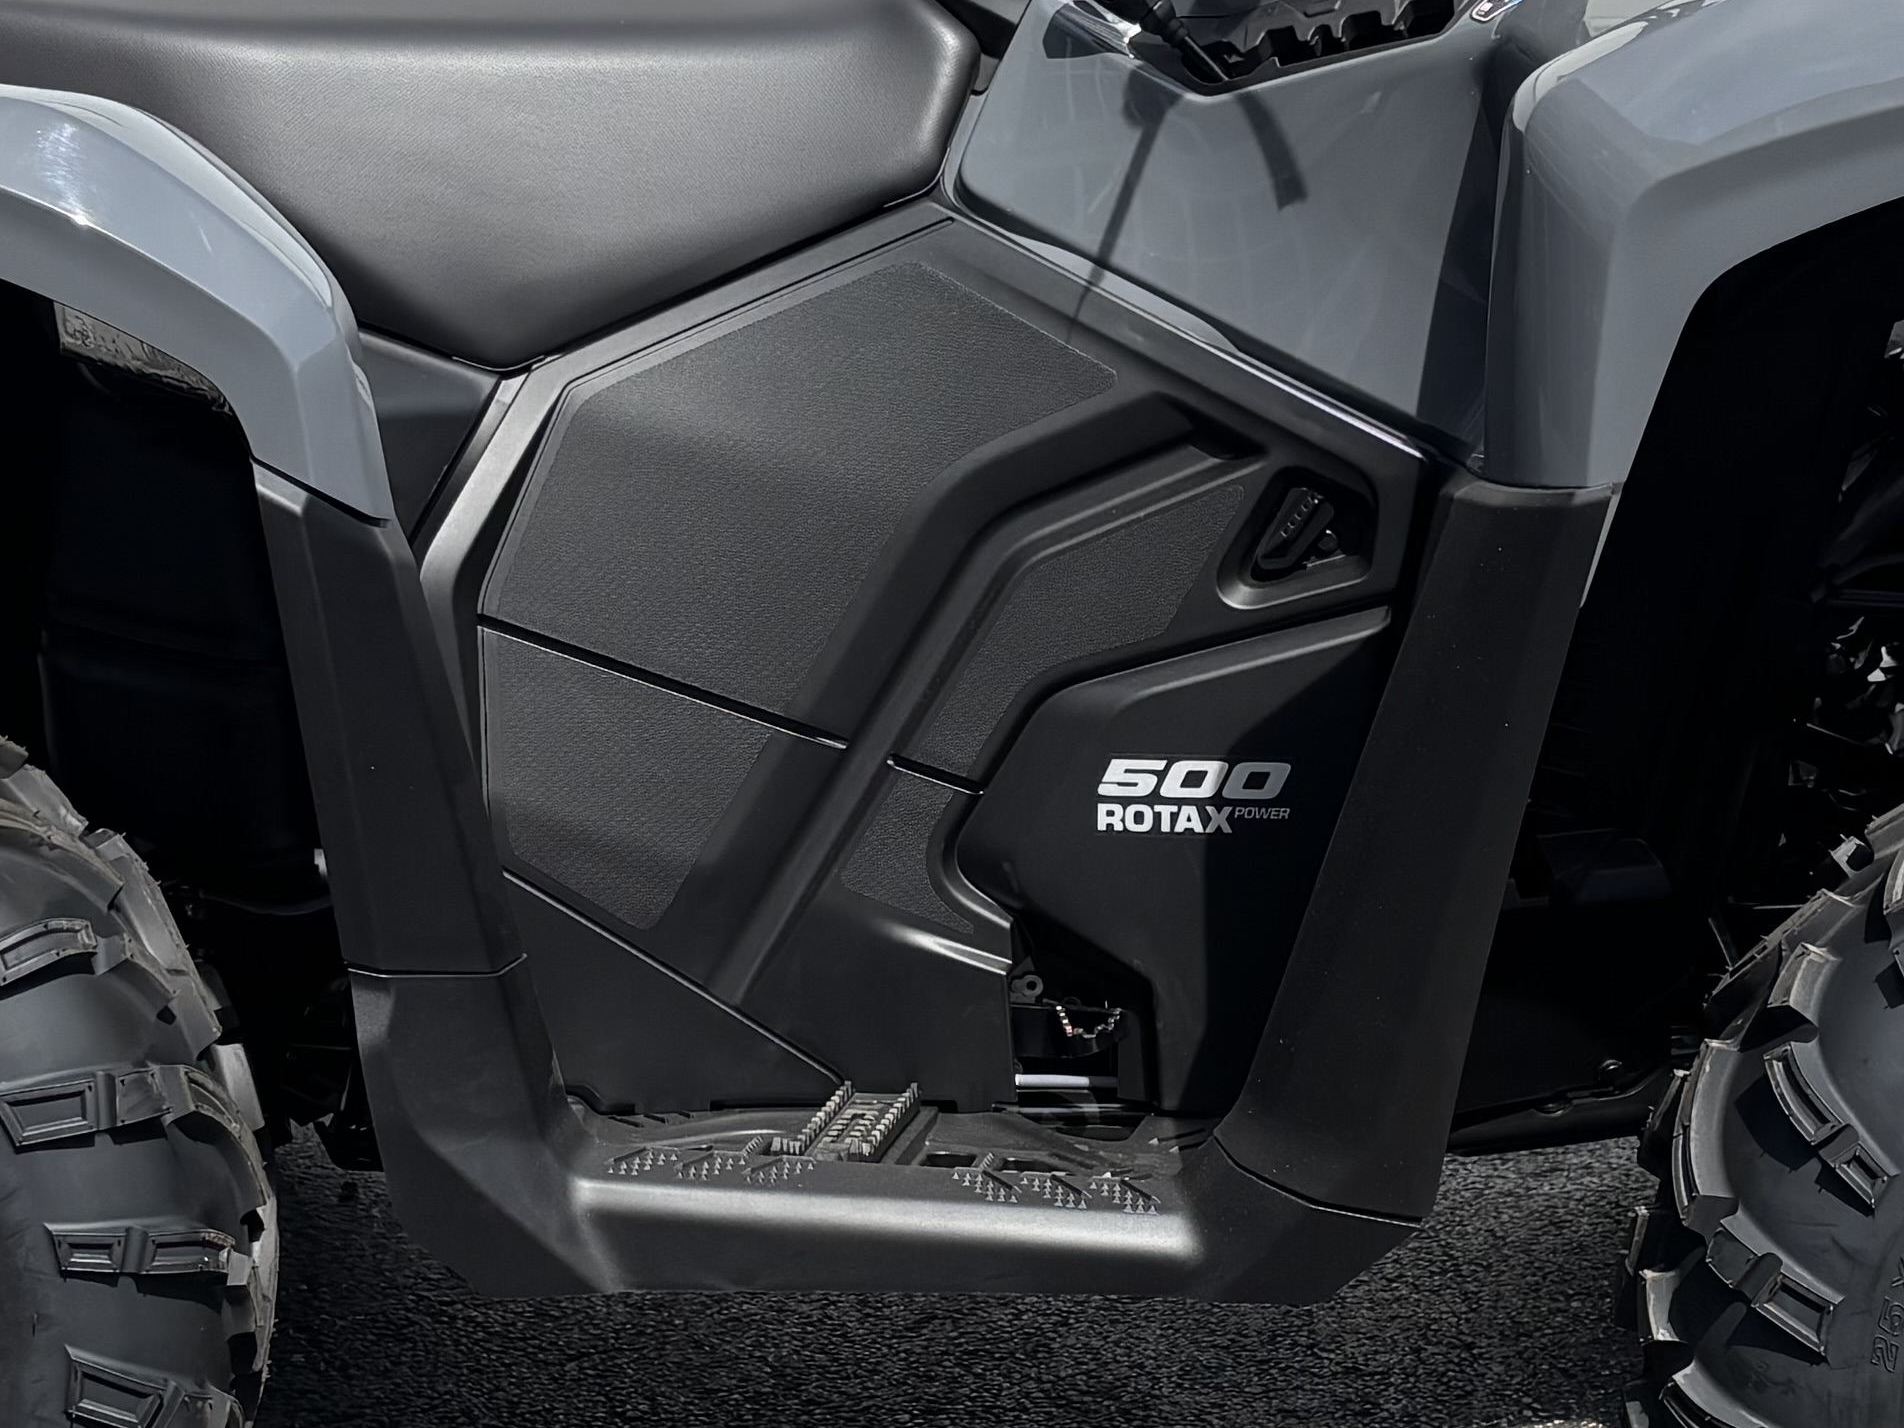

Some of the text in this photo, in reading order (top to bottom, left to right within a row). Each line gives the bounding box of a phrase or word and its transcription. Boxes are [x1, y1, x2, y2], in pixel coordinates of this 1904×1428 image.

[1097, 759, 1292, 799] 500
[1097, 804, 1290, 833] ROTAX POWER
